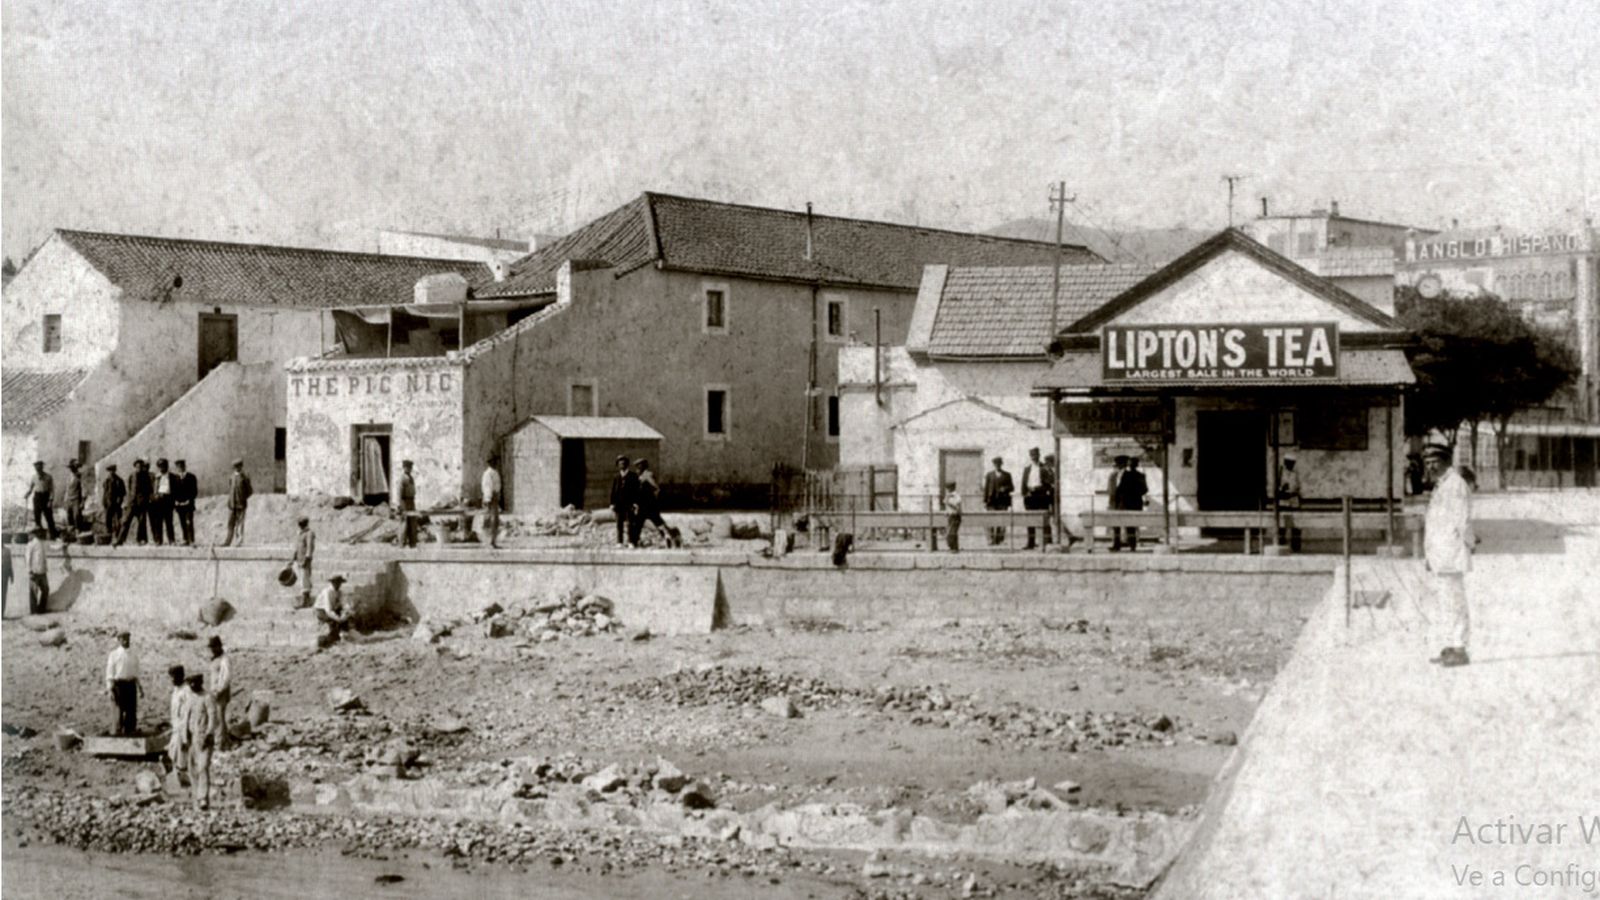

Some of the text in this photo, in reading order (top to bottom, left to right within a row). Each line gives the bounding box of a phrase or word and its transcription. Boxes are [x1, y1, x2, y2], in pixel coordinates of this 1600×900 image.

[1419, 233, 1576, 259] ANGLO HISPANO
[1108, 327, 1333, 369] LIPTON'S TEA
[291, 373, 451, 397] THE PIC NIC
[1126, 368, 1314, 379] LARGEST SALE IN THE WORLD
